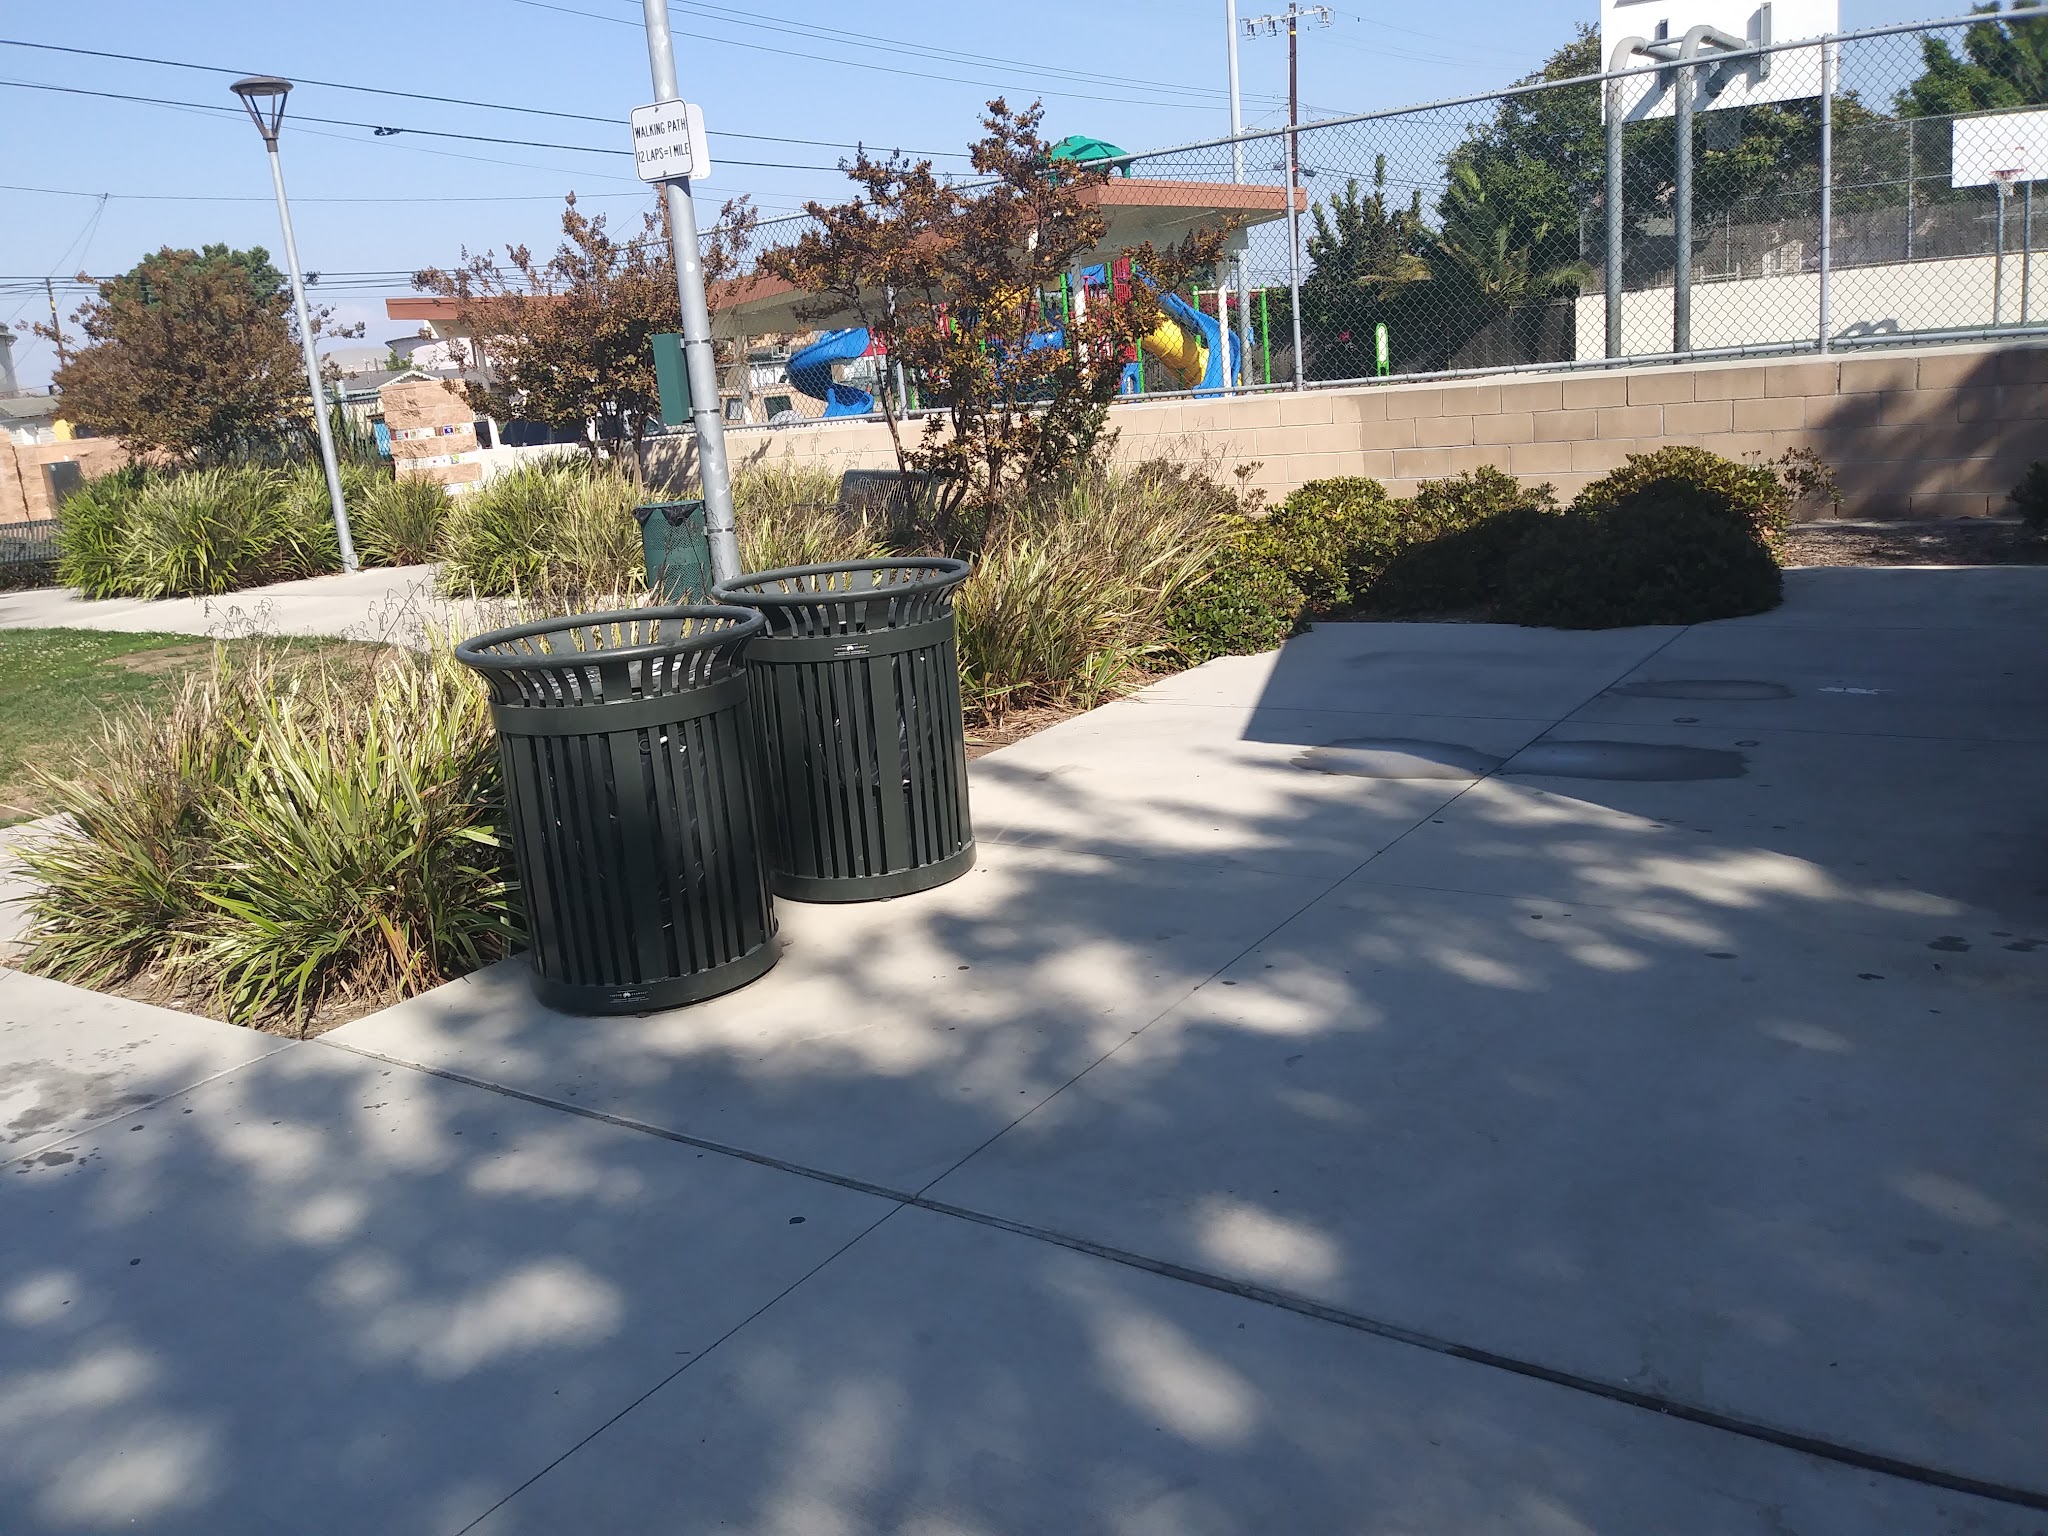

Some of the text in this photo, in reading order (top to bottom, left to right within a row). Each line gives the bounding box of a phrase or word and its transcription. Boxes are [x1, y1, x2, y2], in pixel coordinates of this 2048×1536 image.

[635, 118, 686, 139] WALKING PATH
[673, 143, 689, 156] MILE
